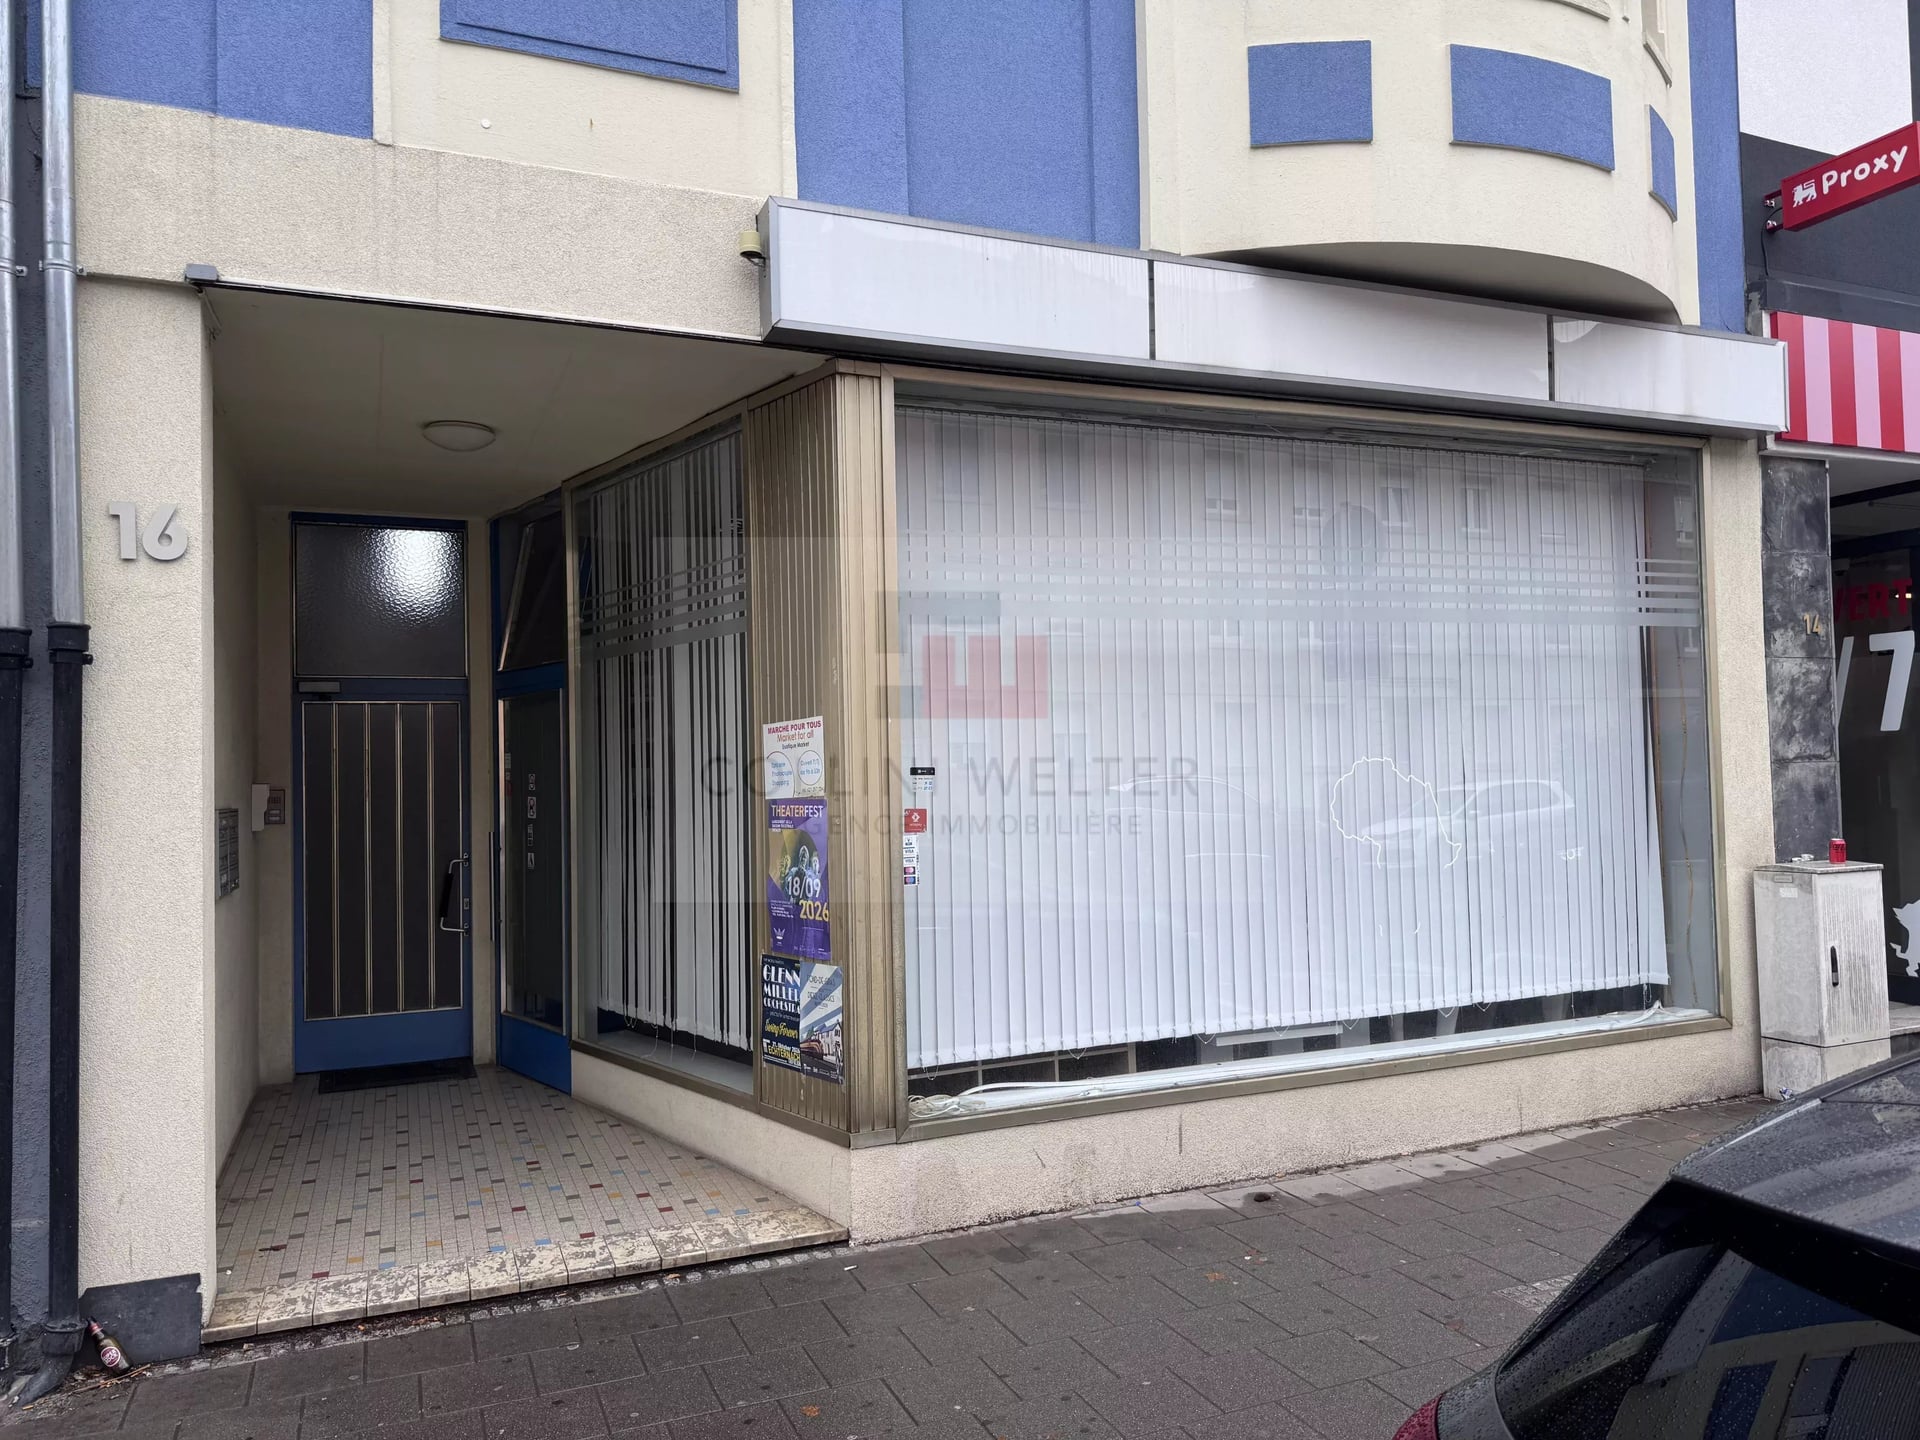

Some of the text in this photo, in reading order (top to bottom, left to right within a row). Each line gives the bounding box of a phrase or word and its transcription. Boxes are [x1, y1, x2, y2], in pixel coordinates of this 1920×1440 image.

[1822, 145, 1908, 195] Proxy
[109, 503, 188, 561] 16
[1803, 613, 1822, 635] 14
[777, 729, 814, 742] Market for all
[790, 722, 806, 731] POUR
[806, 720, 821, 729] TOUS
[771, 804, 824, 818] THEATERFEST
[787, 876, 821, 898] 18/09
[799, 900, 829, 922] 2026
[763, 964, 800, 987] GLENN
